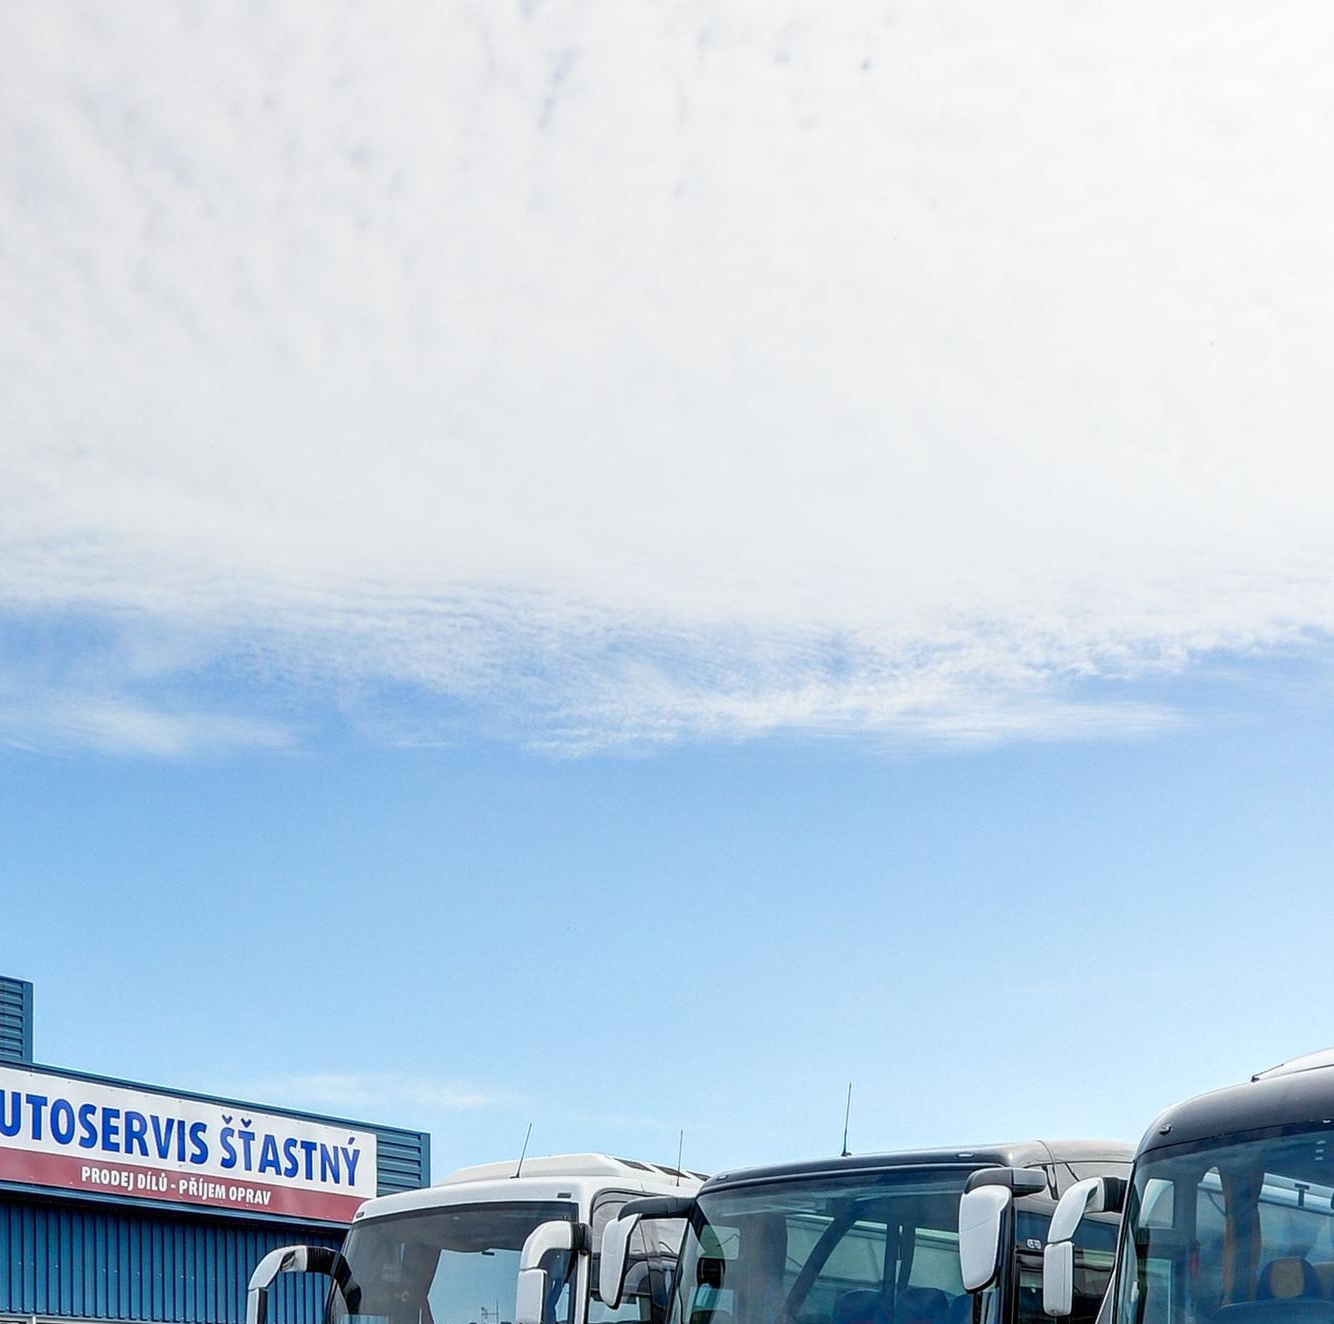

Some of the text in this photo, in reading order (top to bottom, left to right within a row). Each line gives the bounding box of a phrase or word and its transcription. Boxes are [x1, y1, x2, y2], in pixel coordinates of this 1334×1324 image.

[221, 1114, 361, 1187] ŠŤASTNÝ
[81, 1166, 271, 1206] PRODEJ DÍLŮ PŘÍJEM OPRAV
